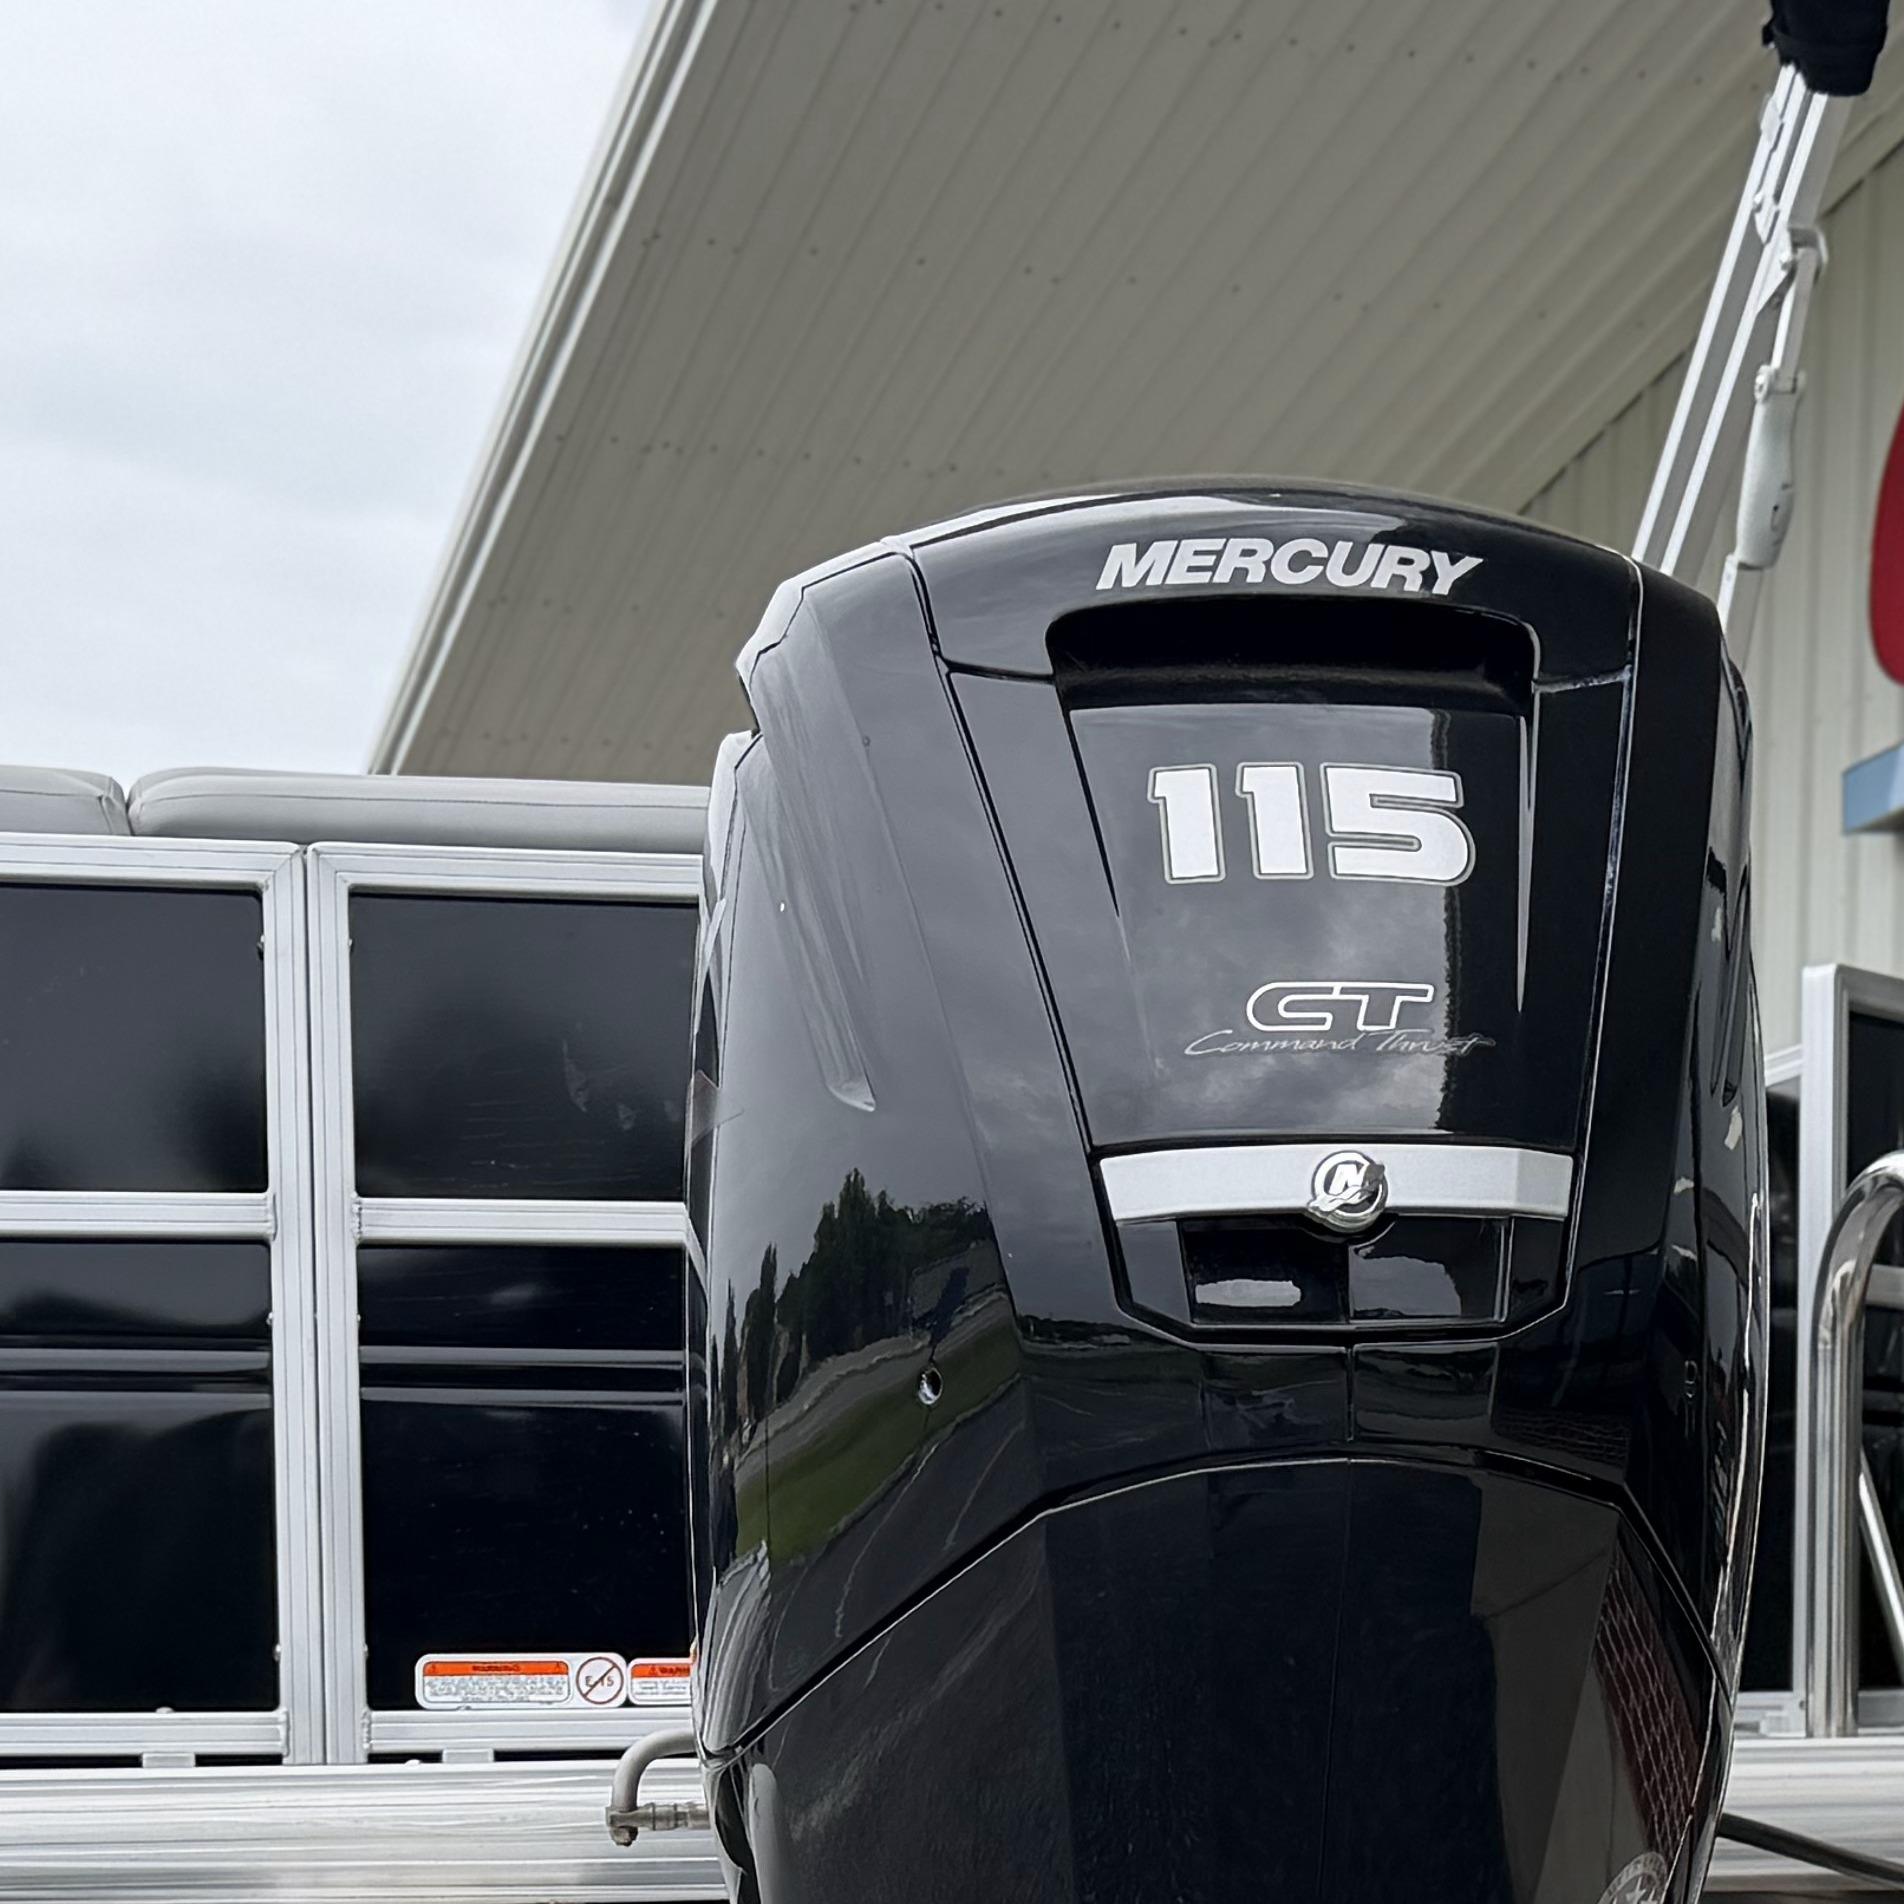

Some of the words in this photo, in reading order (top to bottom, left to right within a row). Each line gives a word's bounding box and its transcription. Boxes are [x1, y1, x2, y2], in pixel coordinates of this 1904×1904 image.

[1096, 537, 1484, 596] MERCURY
[1147, 761, 1476, 887] 115
[1246, 981, 1435, 1031] CT
[1183, 1029, 1364, 1056] Command
[1358, 1028, 1497, 1055] Thrust
